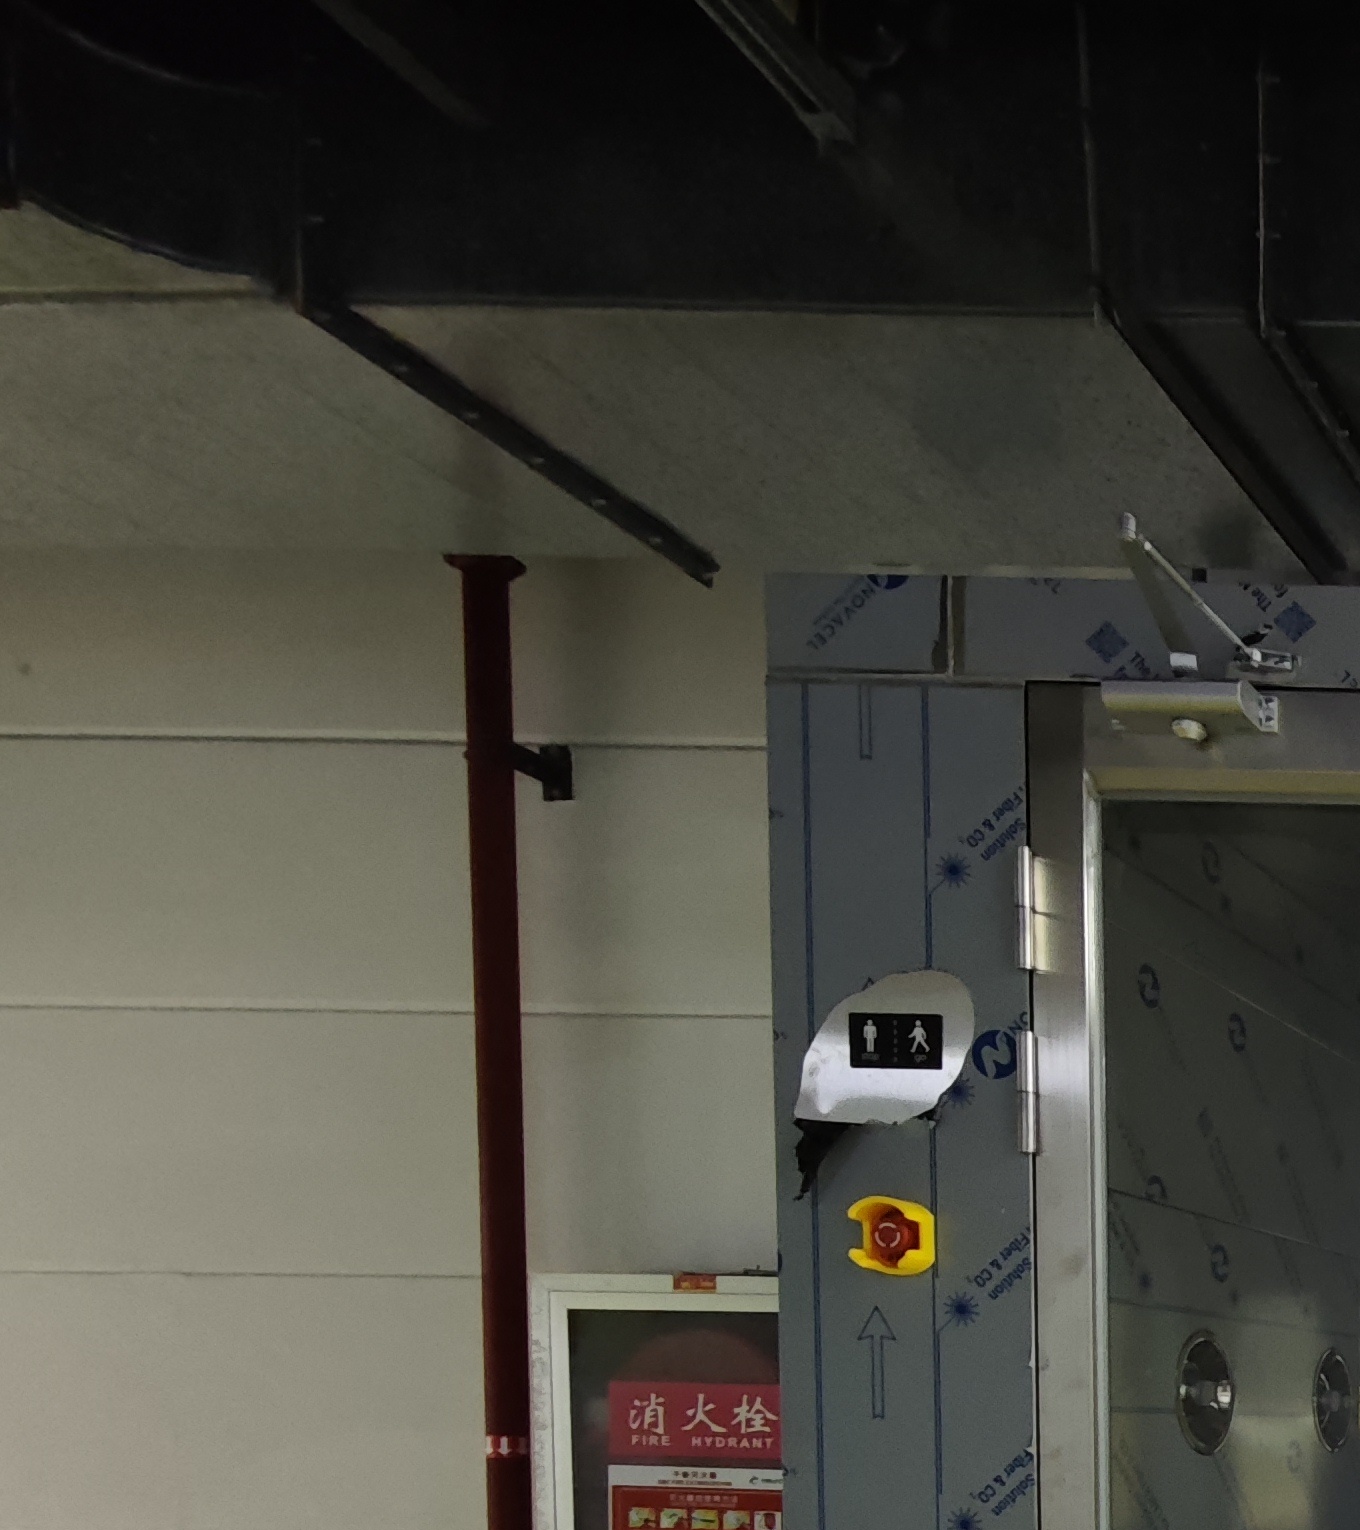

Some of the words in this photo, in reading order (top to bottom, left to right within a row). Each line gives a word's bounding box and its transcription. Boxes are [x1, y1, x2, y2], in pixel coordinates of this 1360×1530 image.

[628, 1393, 779, 1434] 消火栓
[631, 1434, 672, 1447] FIRE
[691, 1436, 775, 1449] HYDRANT
